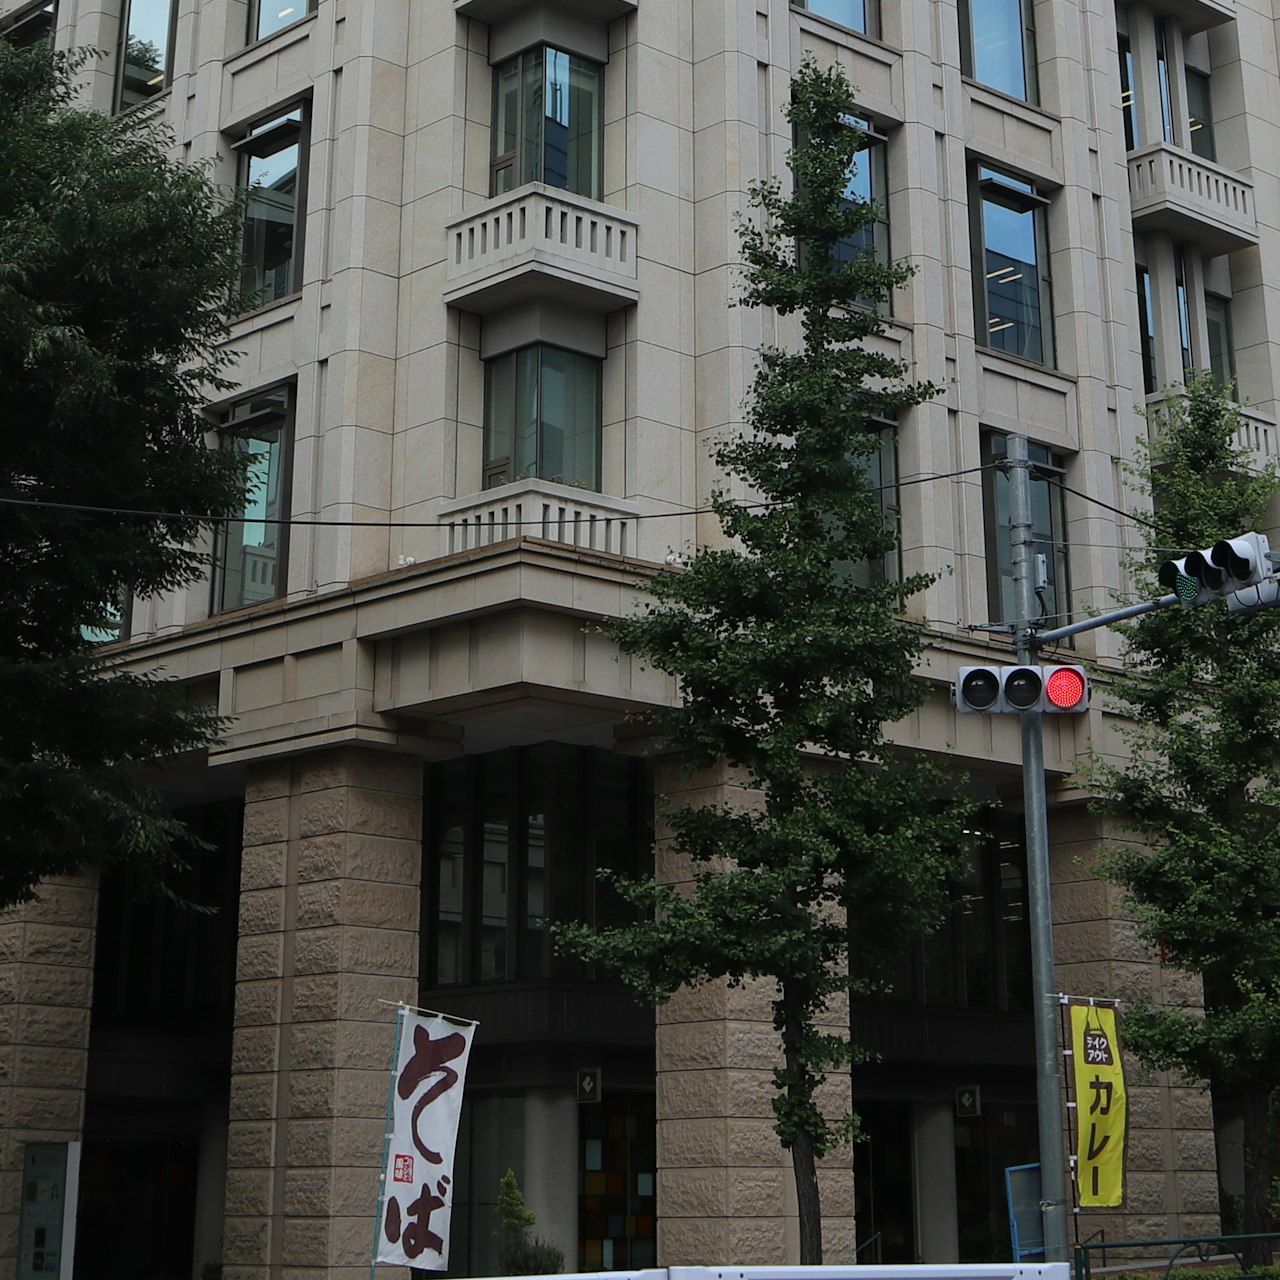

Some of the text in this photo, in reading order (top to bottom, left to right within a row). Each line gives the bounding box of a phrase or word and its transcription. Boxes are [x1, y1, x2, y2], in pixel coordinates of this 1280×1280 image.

[1086, 1036, 1107, 1050] テイク
[1087, 1049, 1109, 1063] アウト
[385, 1024, 466, 1259] そば
[1087, 1074, 1113, 1196] カレー
